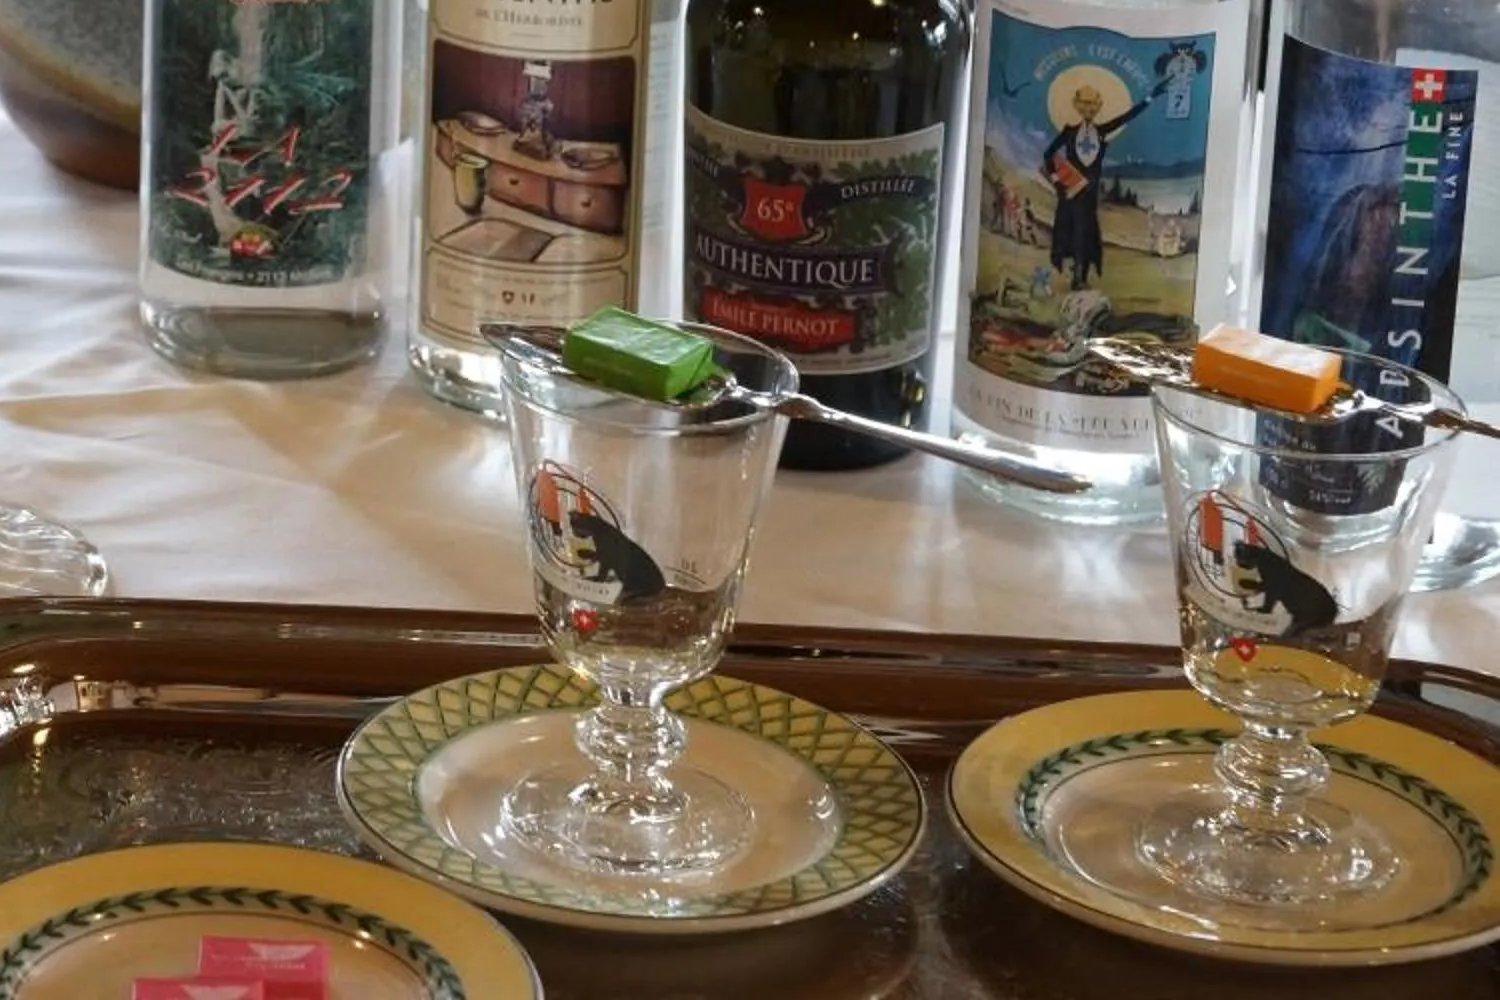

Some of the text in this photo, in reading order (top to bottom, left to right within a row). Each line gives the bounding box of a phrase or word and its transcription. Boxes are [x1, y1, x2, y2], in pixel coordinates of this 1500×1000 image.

[1442, 112, 1463, 199] LA FINE
[1374, 110, 1443, 440] ABSINTHE
[762, 311, 840, 336] PERNOT
